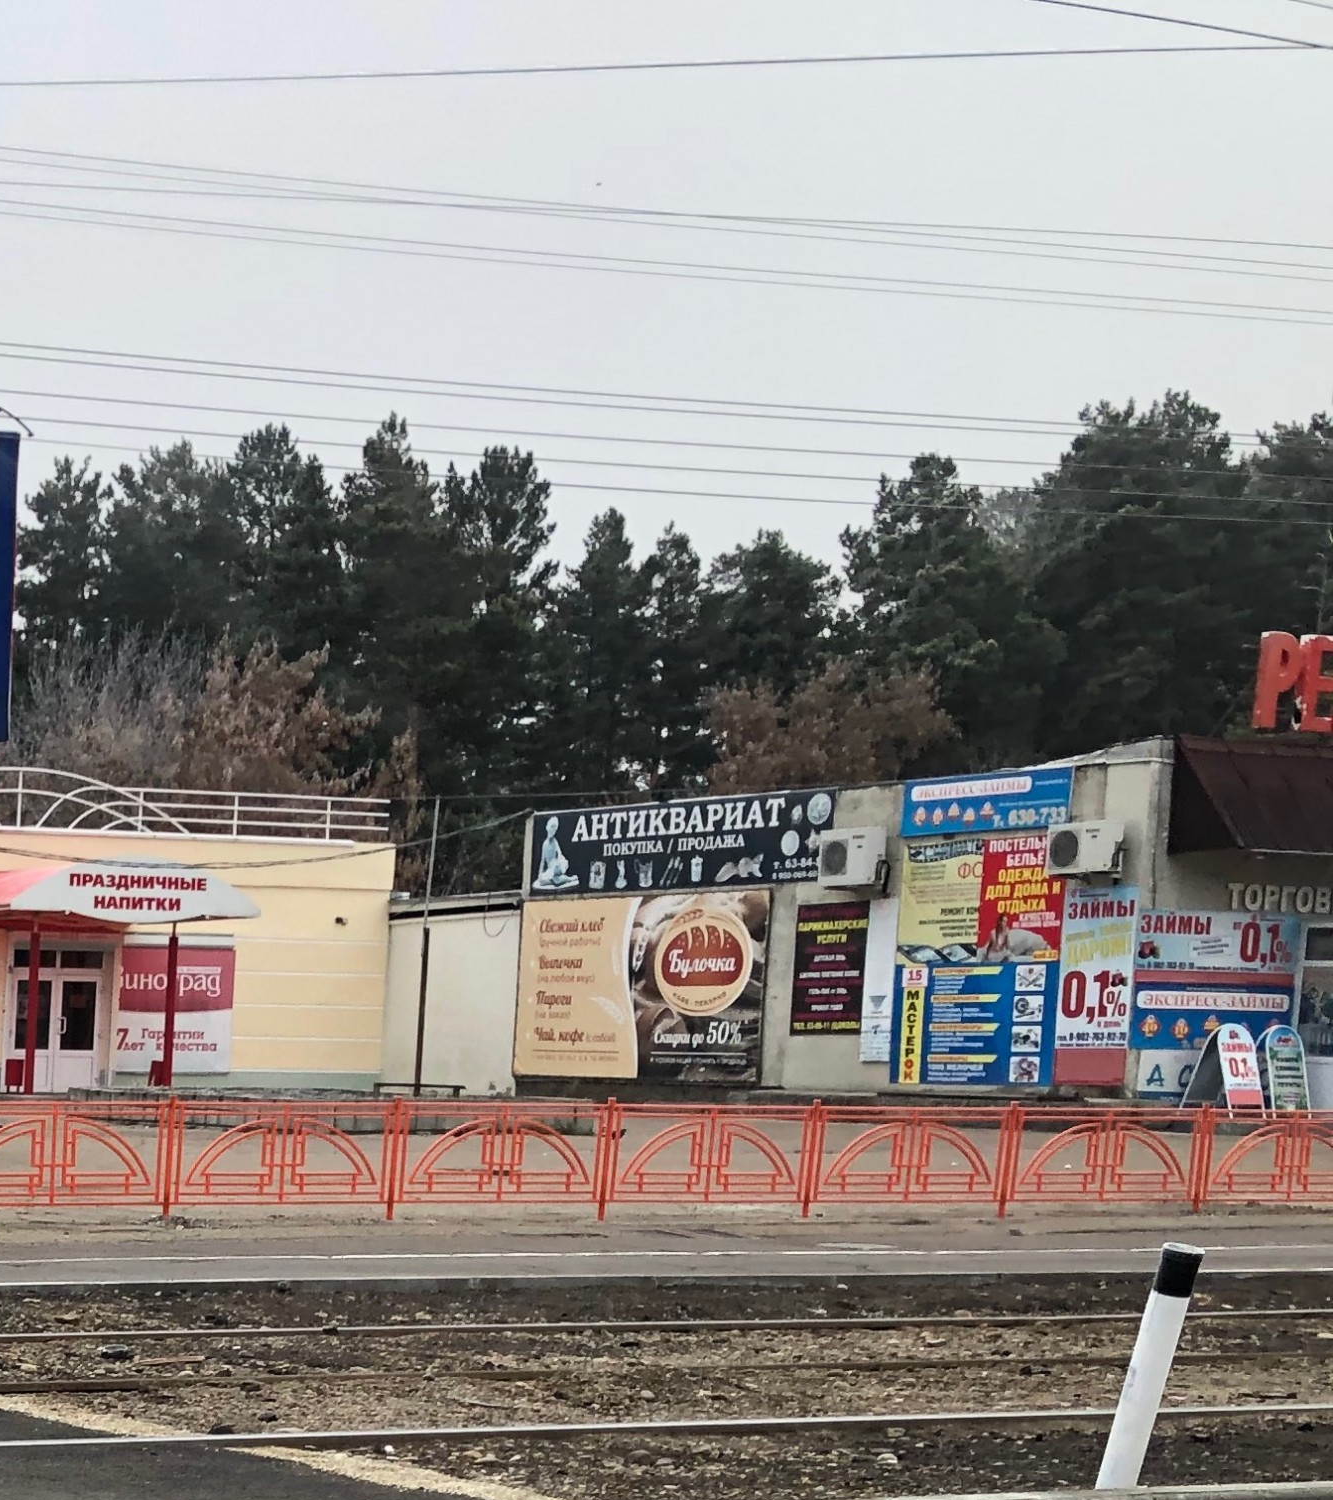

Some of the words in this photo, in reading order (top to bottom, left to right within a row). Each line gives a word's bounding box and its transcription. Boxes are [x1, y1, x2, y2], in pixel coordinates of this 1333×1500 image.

[572, 797, 786, 843] АНТИКВАРИАТ
[603, 839, 664, 857] ПОКУПКА
[677, 834, 745, 852] ПРОДАЖА
[69, 872, 208, 892] ПРАЗДНИЧНЫЕ
[998, 867, 1050, 884] ОДЕЖДА
[985, 884, 1011, 901] ДЛЯ
[1014, 882, 1049, 899] ДОМА
[1052, 881, 1062, 895] И
[93, 895, 182, 912] НАПИТКИ
[996, 898, 1047, 915] ОТДЫХА
[1068, 898, 1136, 920] ЗАЙМЫ
[816, 934, 848, 945] УСЛУГИ
[1140, 911, 1213, 936] ЗАЙМЫ
[1240, 921, 1293, 969] 0,1%
[538, 955, 584, 970] Выпечка
[668, 948, 737, 979] Булочка
[908, 970, 923, 981] 15
[536, 991, 573, 1010] Пироги
[1061, 970, 1127, 1025] 0,1%
[1143, 994, 1285, 1010] ЭКСПРЕСС-ЗАЙМЫ
[116, 1028, 130, 1051] 7
[141, 1028, 205, 1041] Гарнтии
[706, 1020, 743, 1045] 50%
[903, 989, 920, 1081] МАСТЕРОК
[156, 1042, 218, 1053] кчества
